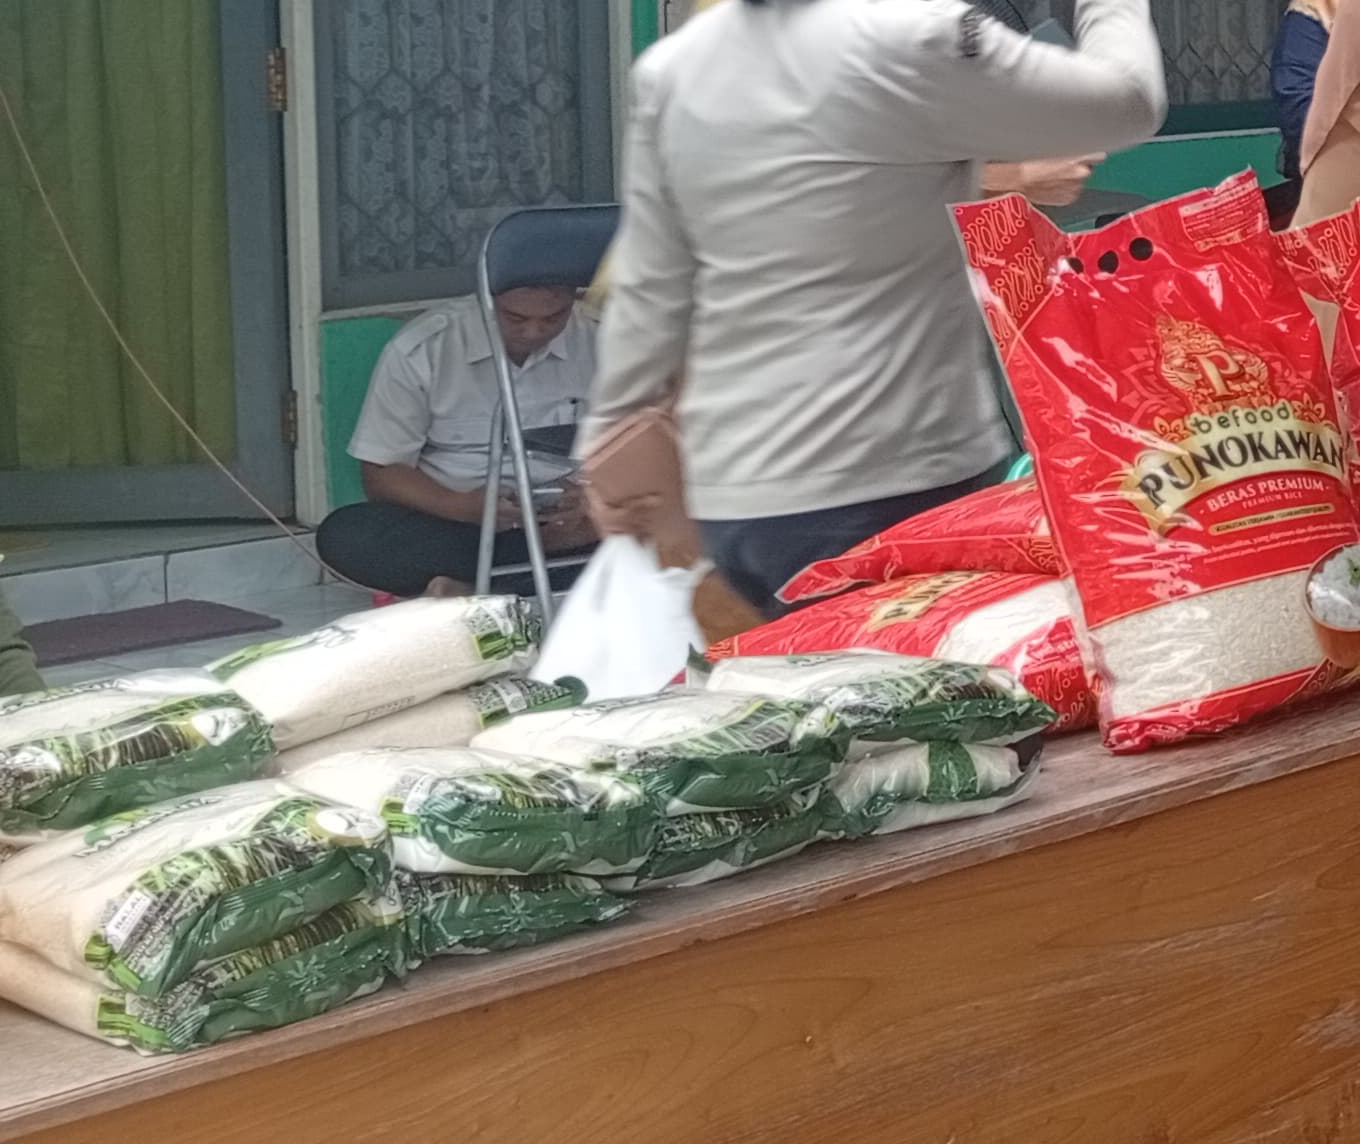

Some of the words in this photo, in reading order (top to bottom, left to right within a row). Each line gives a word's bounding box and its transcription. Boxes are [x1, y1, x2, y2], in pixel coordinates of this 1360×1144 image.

[1190, 403, 1292, 435] befood
[1138, 428, 1346, 510] PUNOKAWAN
[1206, 481, 1256, 513] BERAS
[1257, 475, 1325, 496] PREMIUM
